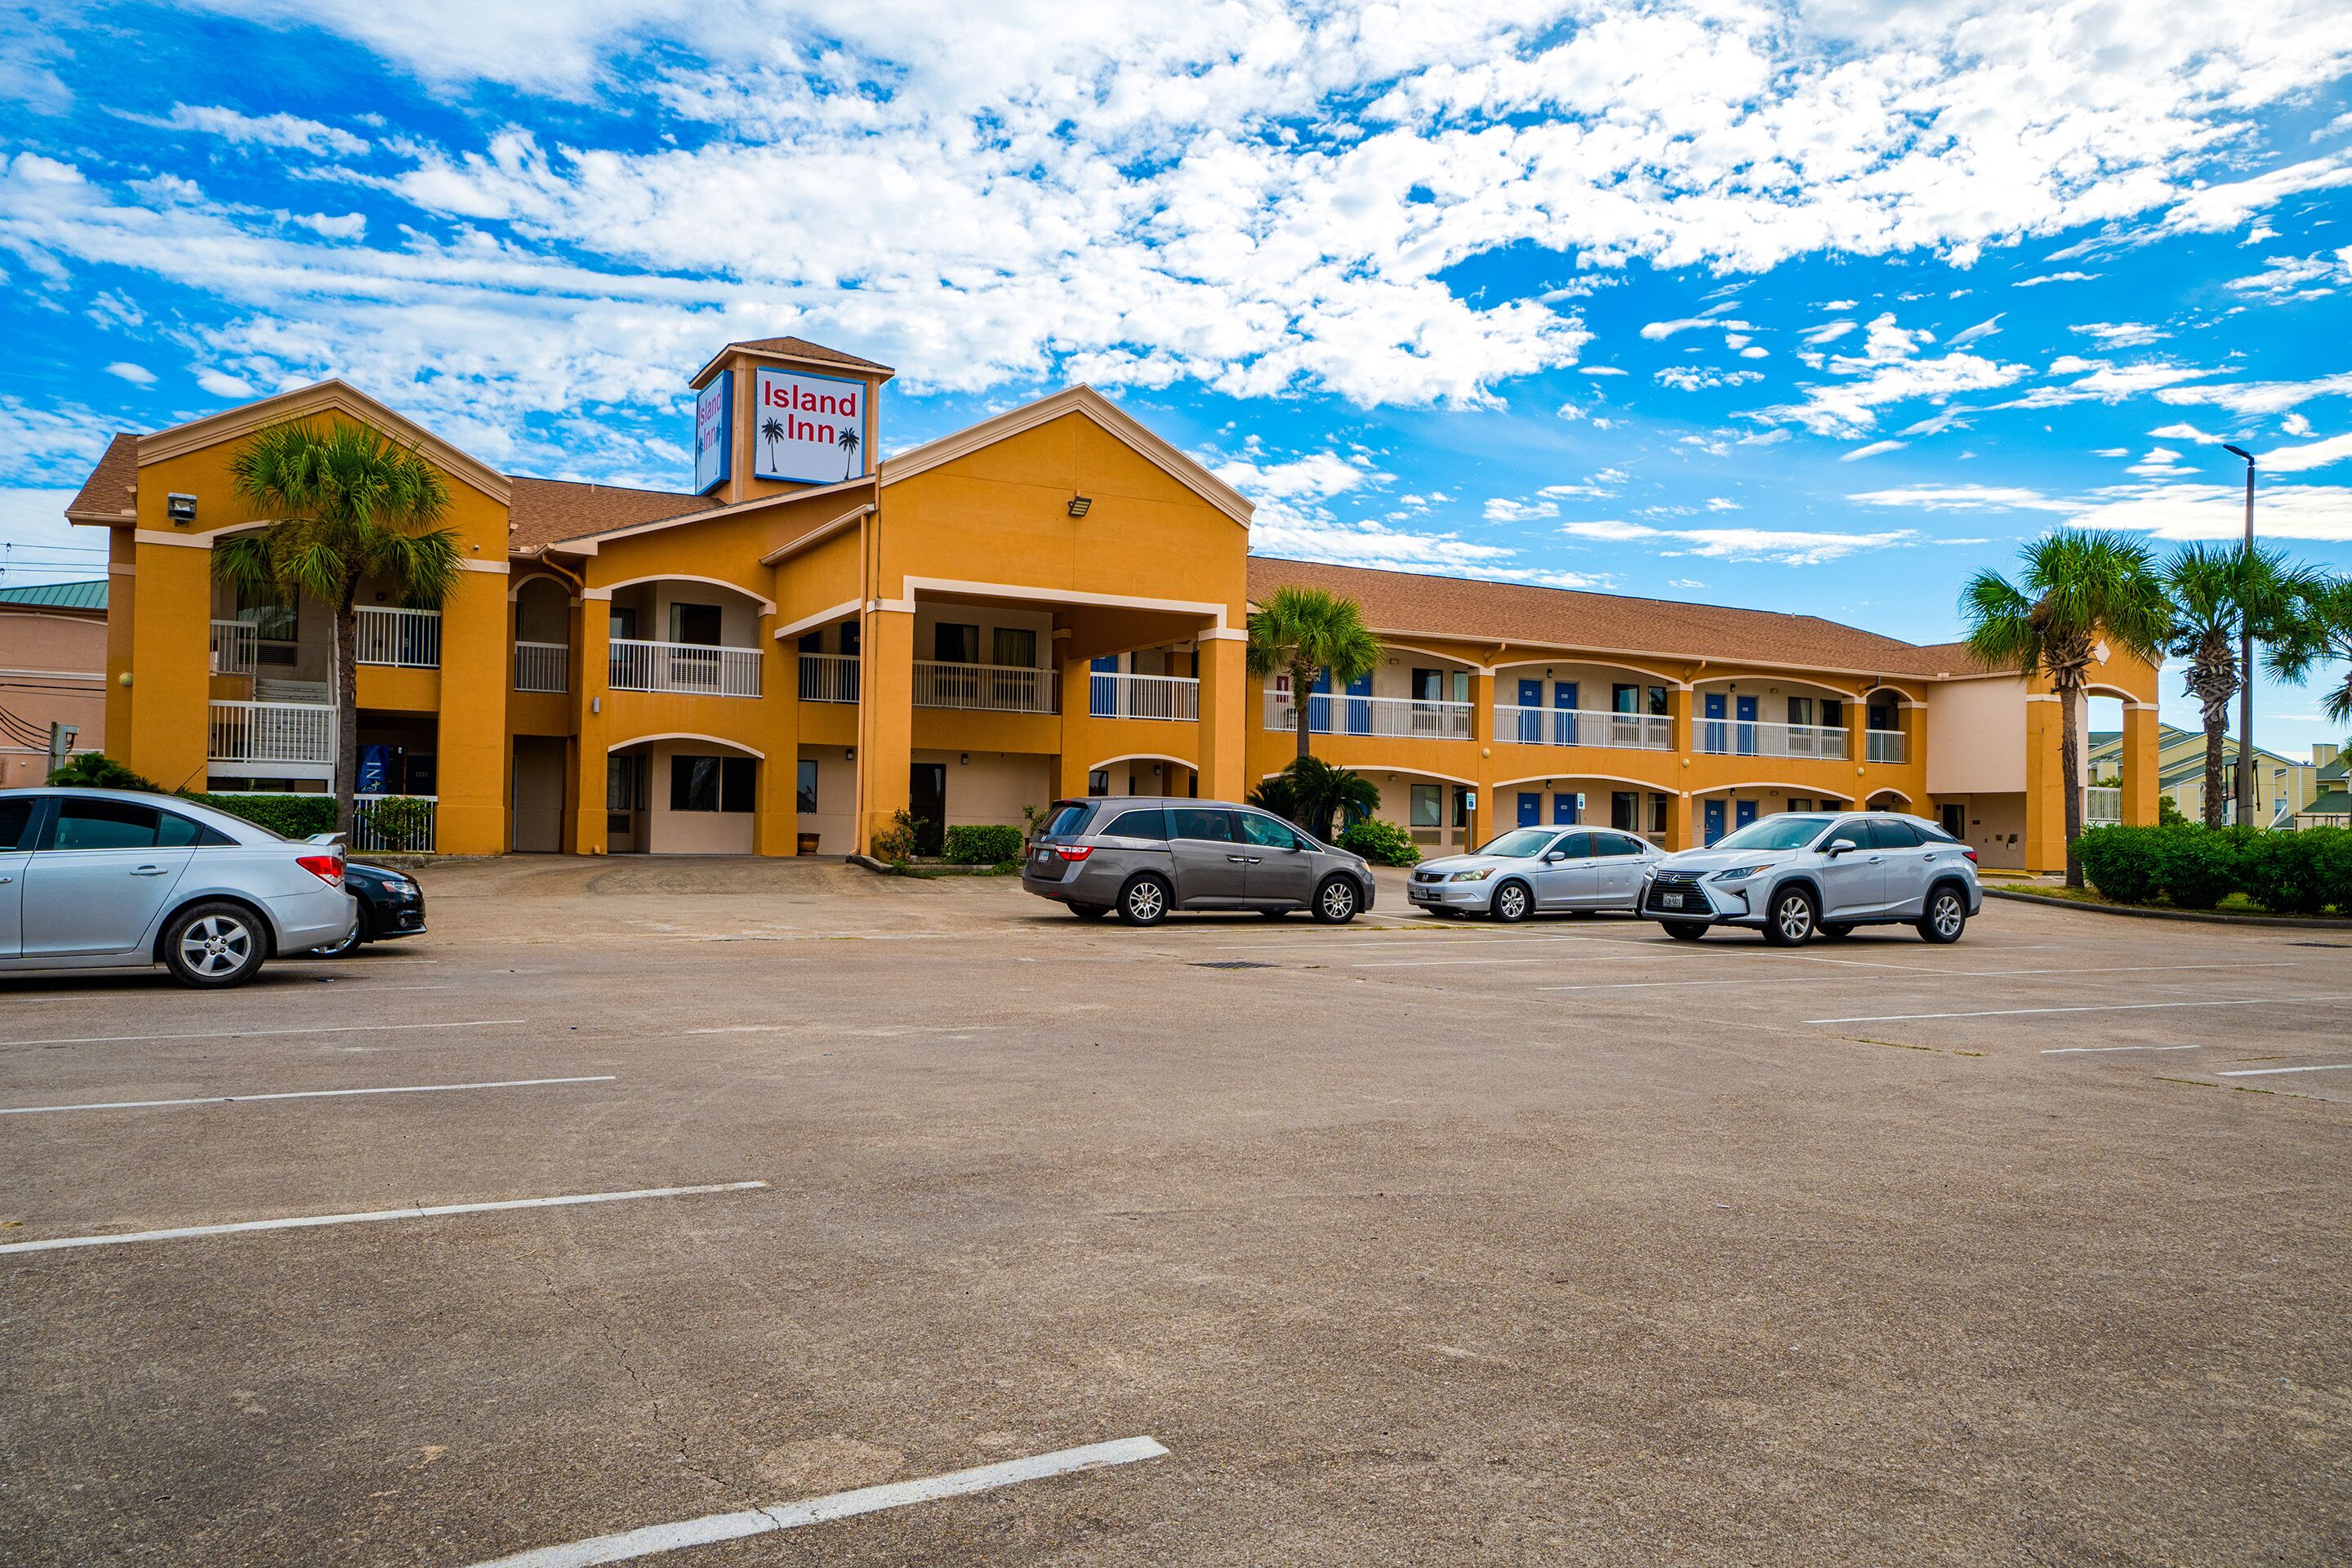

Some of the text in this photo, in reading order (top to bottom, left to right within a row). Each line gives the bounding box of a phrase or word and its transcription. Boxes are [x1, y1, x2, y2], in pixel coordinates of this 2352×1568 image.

[698, 385, 722, 429] Island
[764, 381, 856, 417] Island
[703, 426, 716, 452] Inn
[787, 413, 835, 444] Inn
